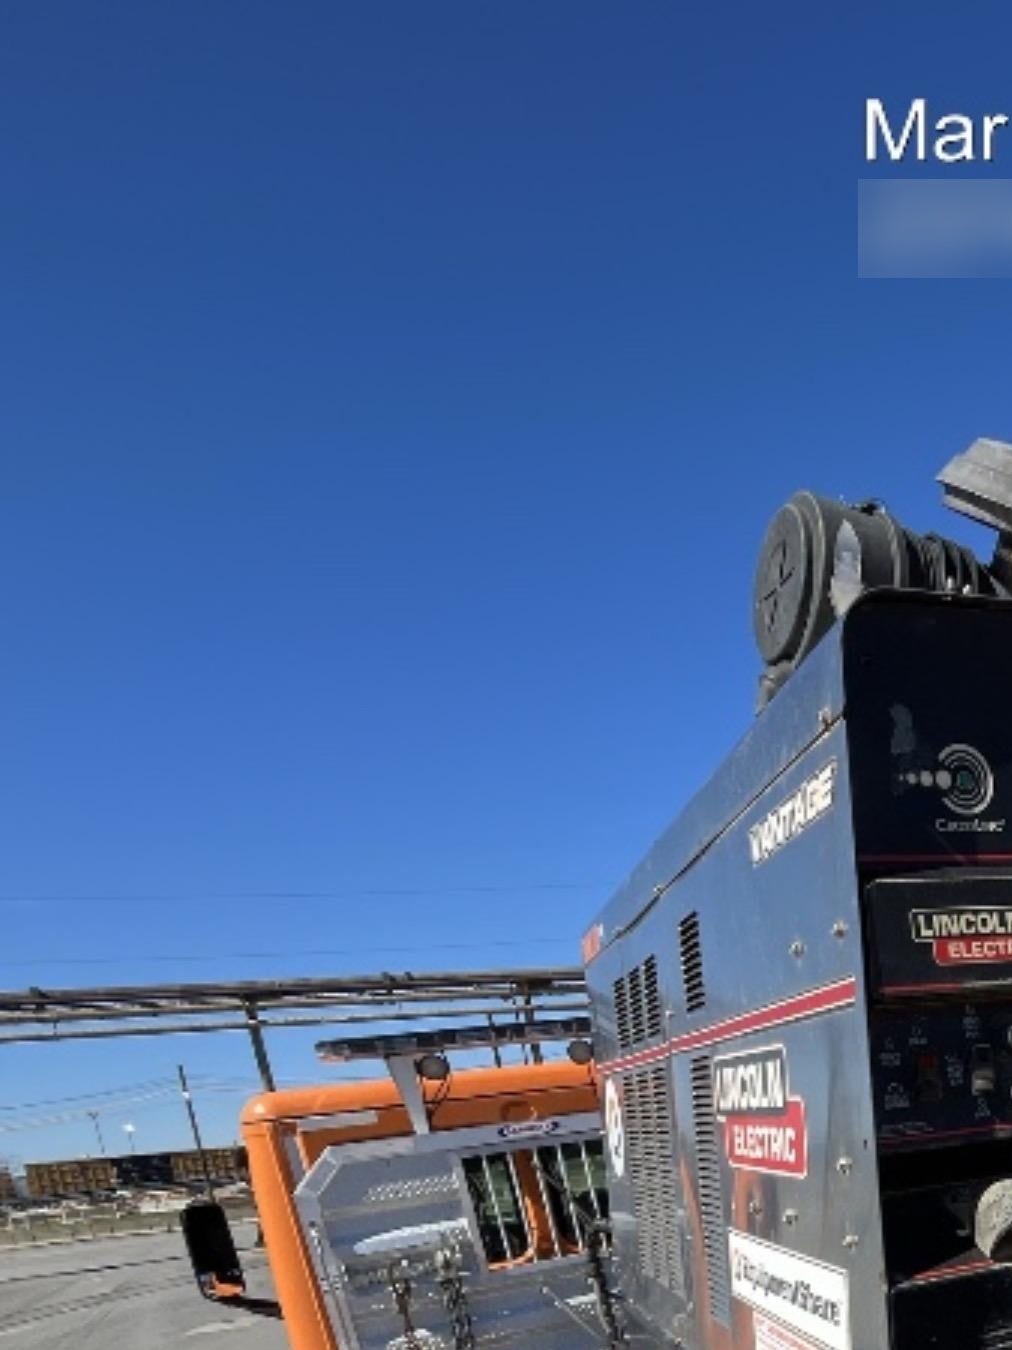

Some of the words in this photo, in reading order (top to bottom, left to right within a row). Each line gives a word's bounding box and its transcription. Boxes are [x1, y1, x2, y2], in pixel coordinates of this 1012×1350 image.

[749, 757, 836, 868] VANTAGE
[717, 1056, 785, 1118] LINCOLN
[733, 1124, 797, 1166] ELECTRIC
